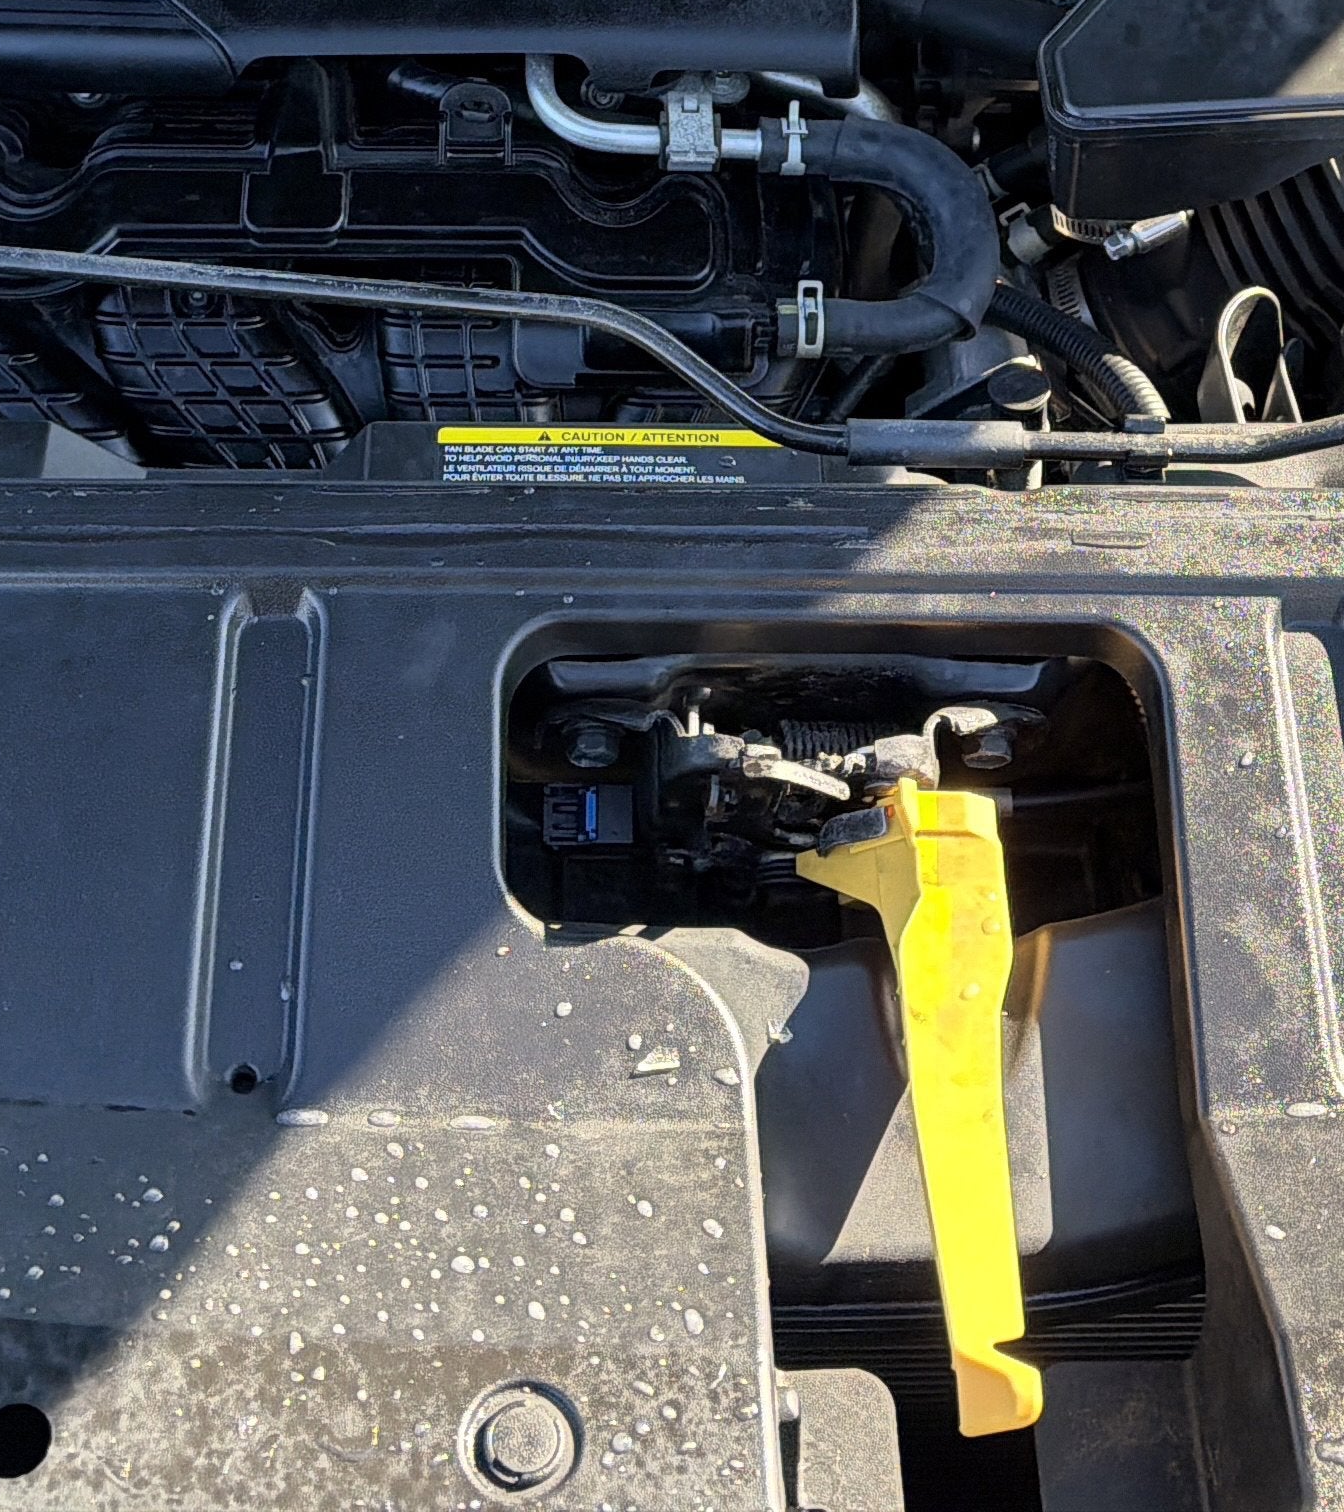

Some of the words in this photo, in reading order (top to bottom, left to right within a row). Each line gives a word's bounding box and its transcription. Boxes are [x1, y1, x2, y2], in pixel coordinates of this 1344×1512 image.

[561, 431, 625, 442] CAUTION
[641, 432, 720, 443] ATTENTION
[444, 445, 463, 453] FAN
[464, 445, 494, 454] BLADE
[496, 445, 516, 454] CAN
[518, 446, 546, 454] START
[547, 446, 559, 454] AT
[560, 446, 580, 454] ANY
[581, 446, 604, 455] TIME.
[444, 454, 457, 462] TO
[459, 454, 483, 462] HELP
[484, 454, 512, 463] AVOID
[514, 454, 563, 463] PERSONAL
[622, 455, 654, 464] HANDS
[656, 455, 688, 464] CLEAR.
[443, 464, 455, 473] LE
[457, 464, 516, 473] VENTILATEUR
[554, 465, 567, 474] DE
[569, 463, 619, 474] DÉMARRER
[630, 466, 653, 475] TOUT
[655, 466, 698, 475] MOMENT.
[443, 473, 471, 482] POUR
[472, 471, 503, 482] ÉVITER
[505, 473, 534, 482] TOUTE
[588, 474, 601, 482] NE
[603, 474, 622, 483] PAS
[637, 475, 696, 484] APPROCHER
[697, 475, 714, 484] LES
